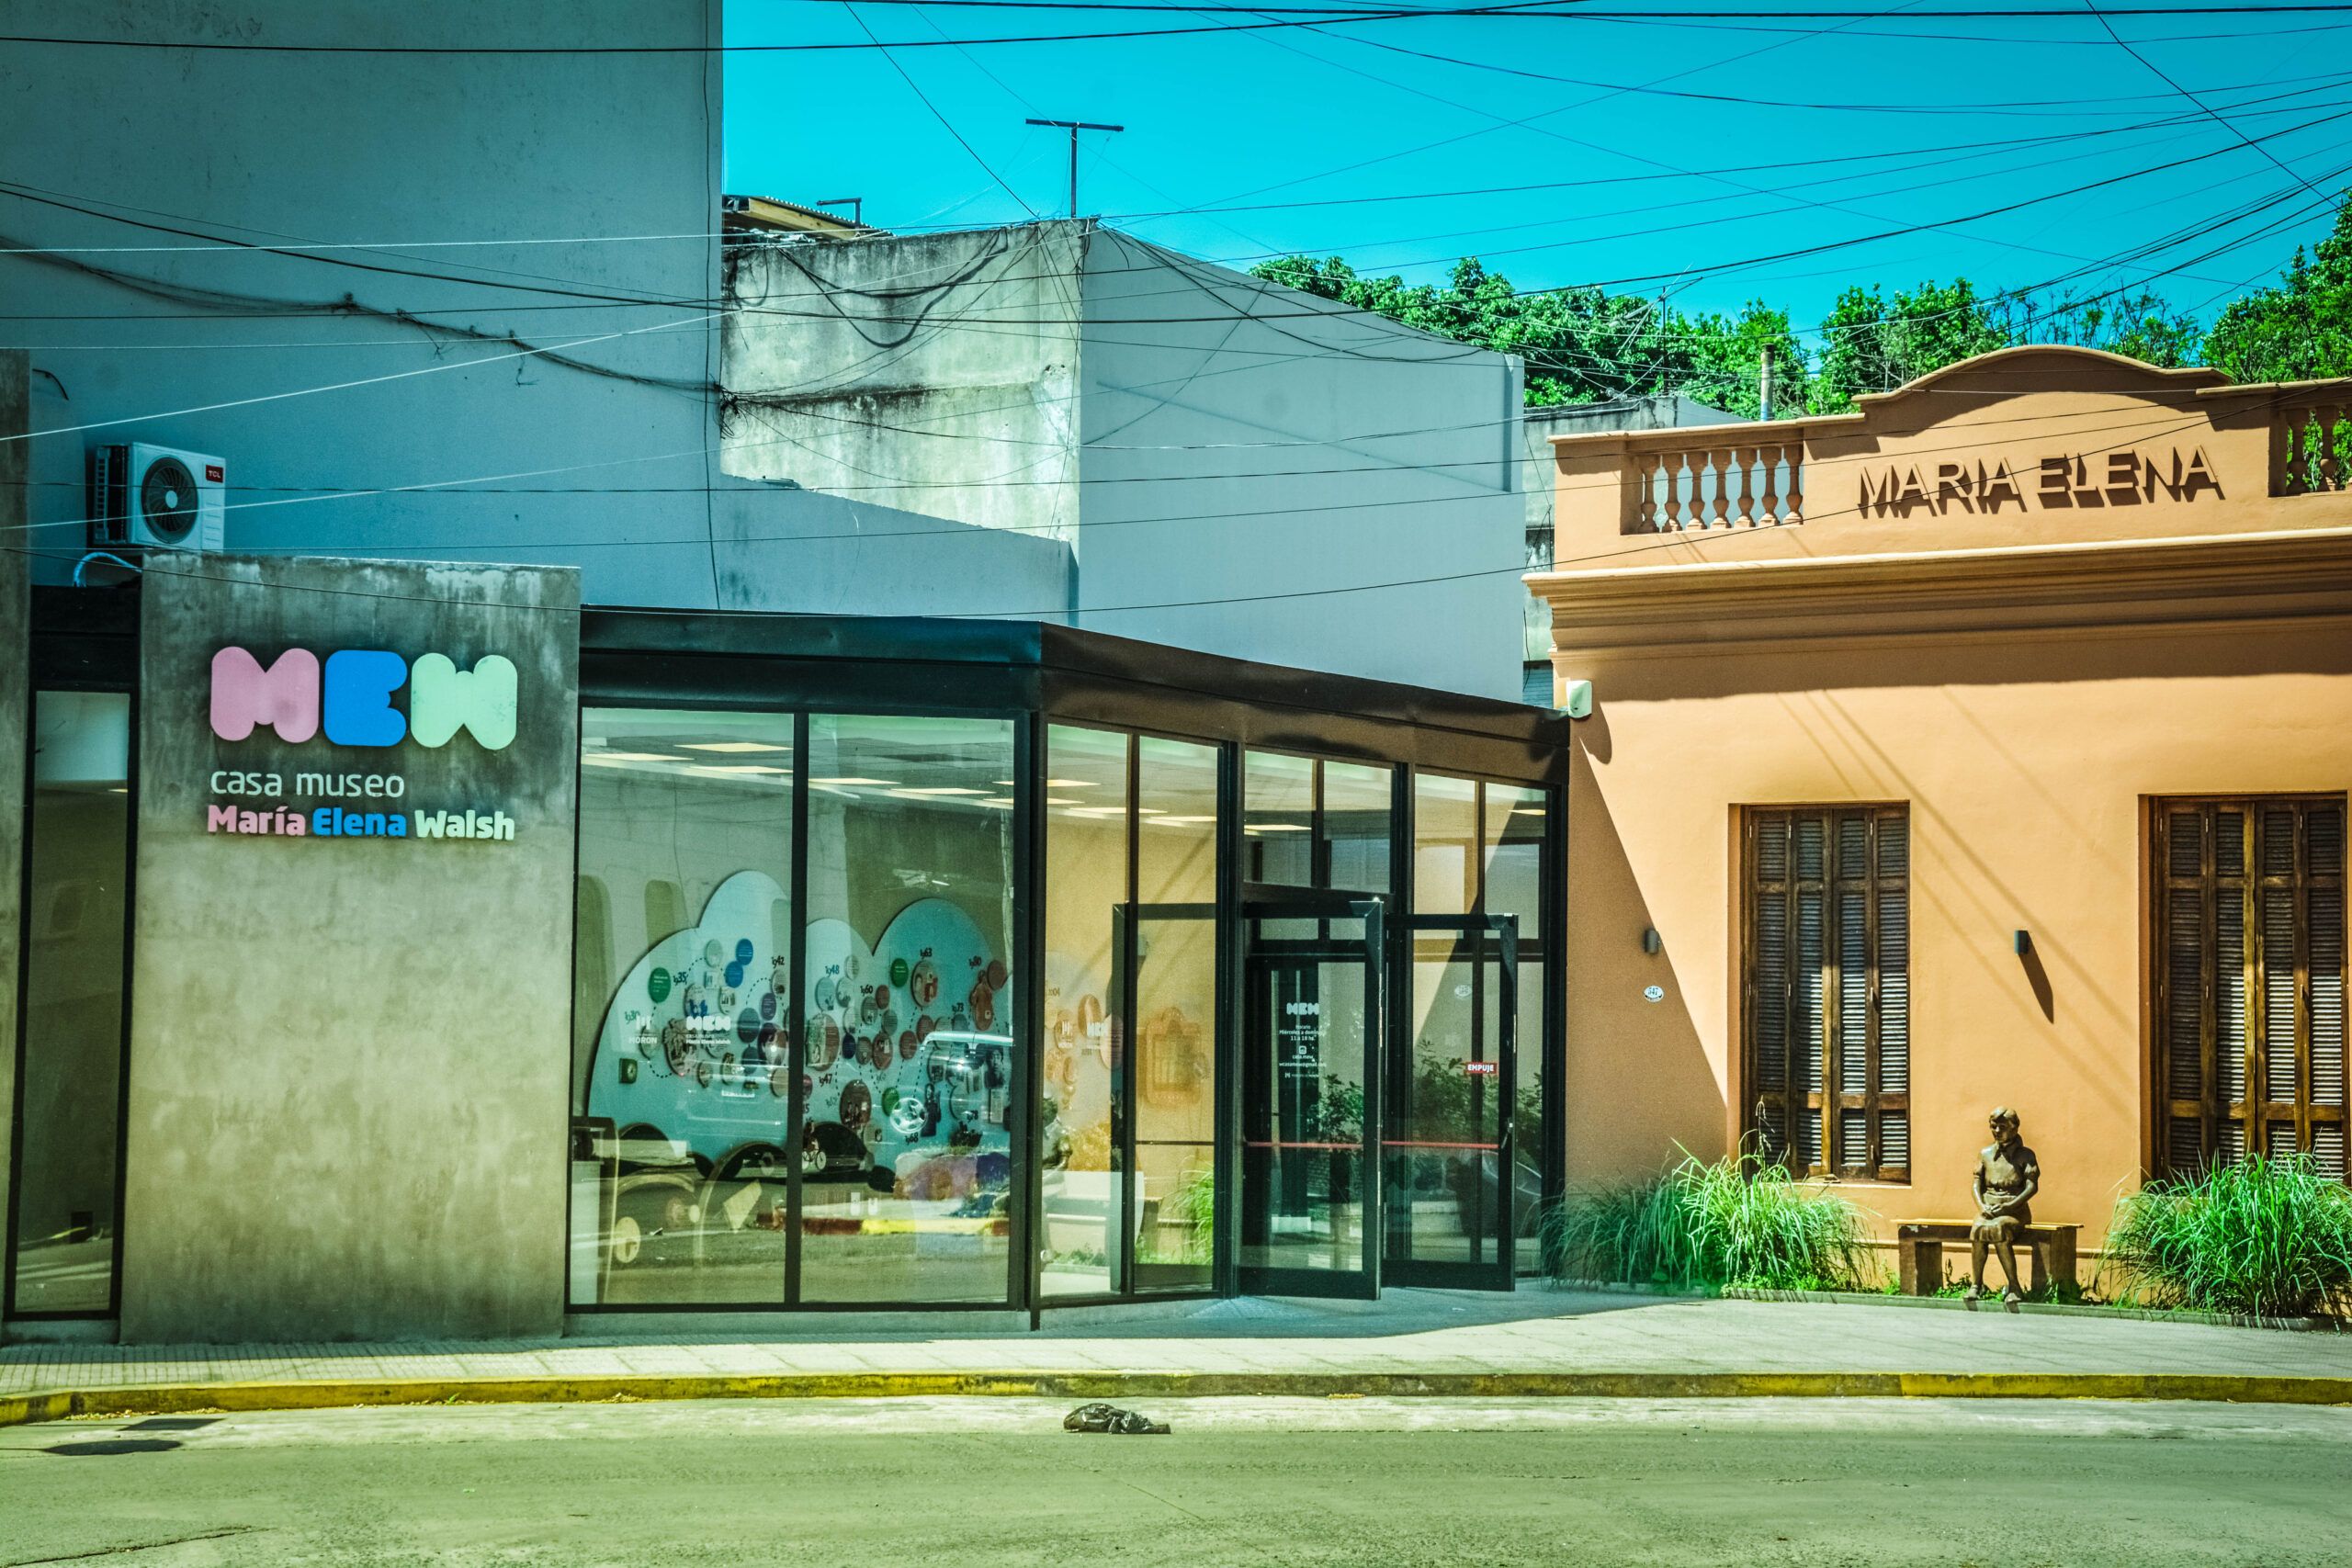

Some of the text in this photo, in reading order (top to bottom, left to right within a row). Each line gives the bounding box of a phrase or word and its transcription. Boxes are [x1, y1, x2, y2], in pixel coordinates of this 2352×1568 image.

[208, 469, 221, 479] TCL
[1857, 445, 2224, 518] MARIA ELENA
[210, 770, 405, 798] casa museo
[208, 805, 515, 840] María Elena Walsh
[825, 964, 839, 977] 1948
